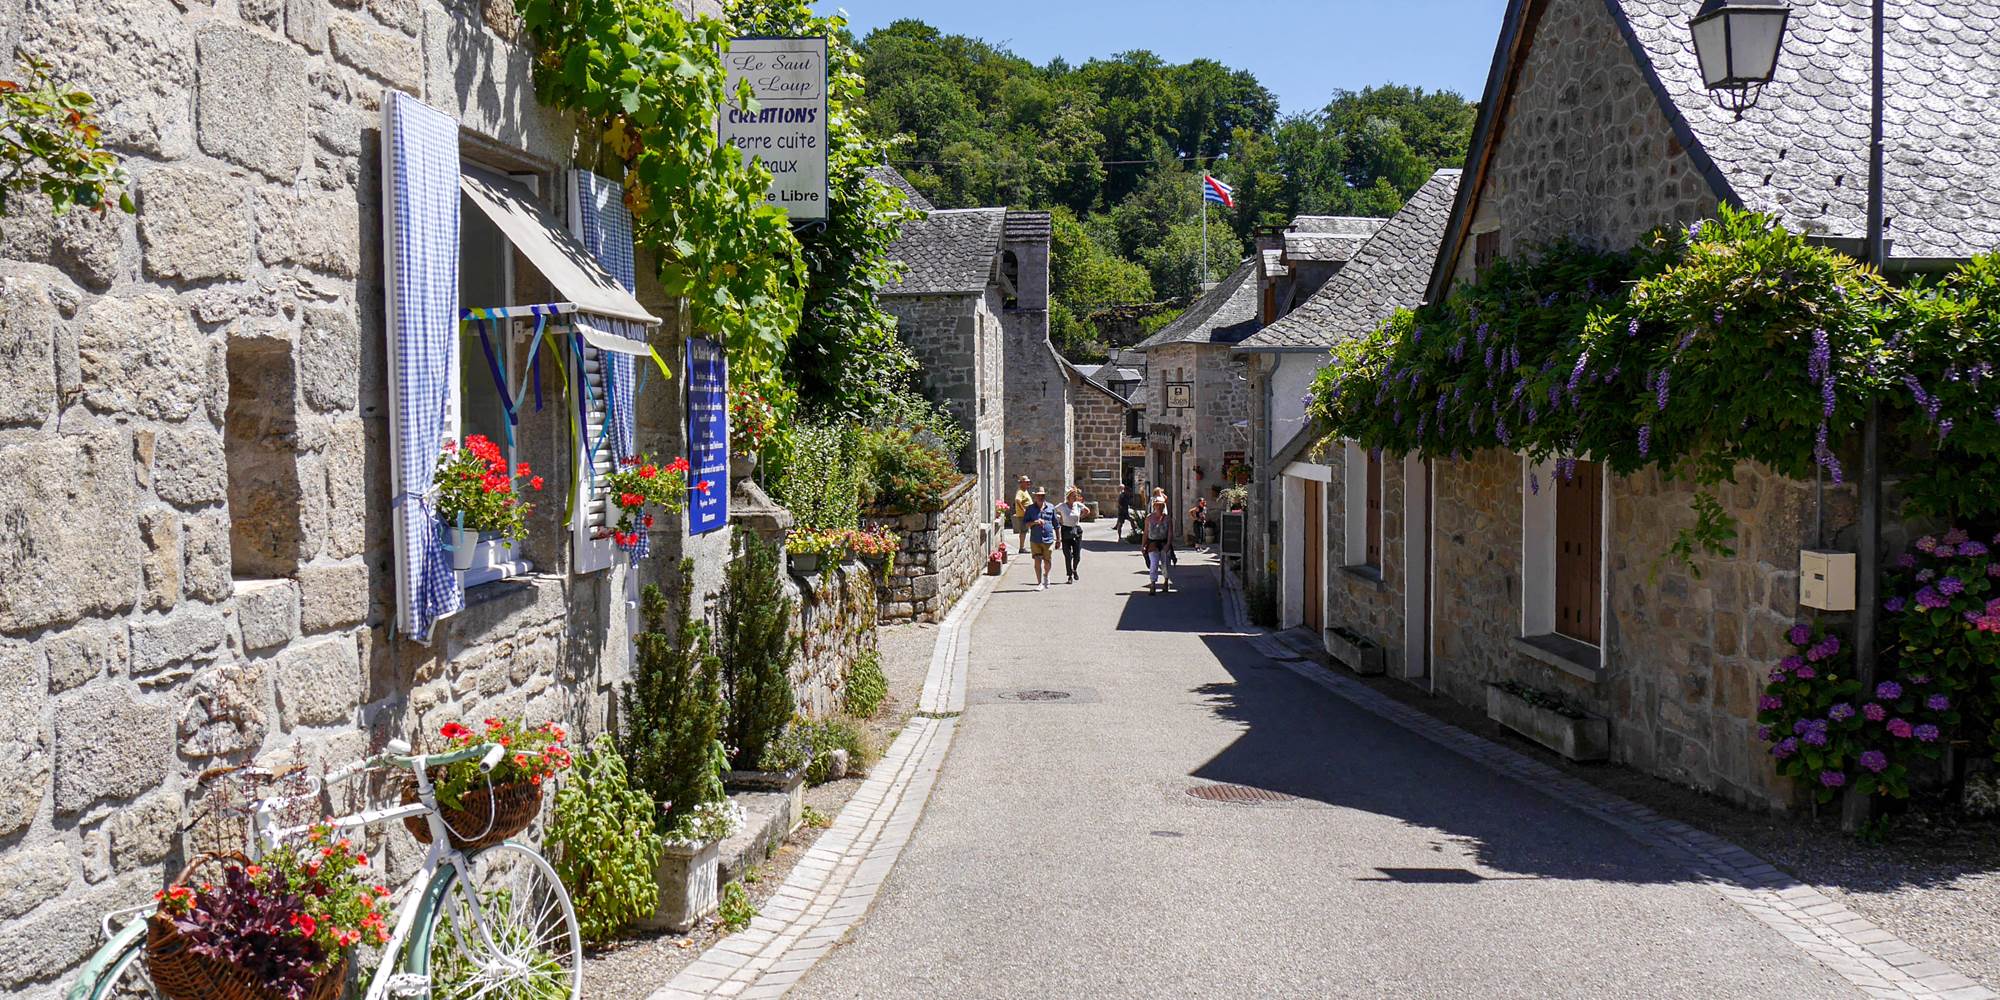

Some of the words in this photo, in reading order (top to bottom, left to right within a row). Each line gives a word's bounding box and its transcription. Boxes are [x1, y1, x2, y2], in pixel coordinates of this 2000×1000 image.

[733, 54, 766, 71] Le
[771, 54, 813, 70] Saut
[758, 75, 813, 96] Loup
[777, 131, 816, 149] cuite
[781, 190, 819, 202] Libre
